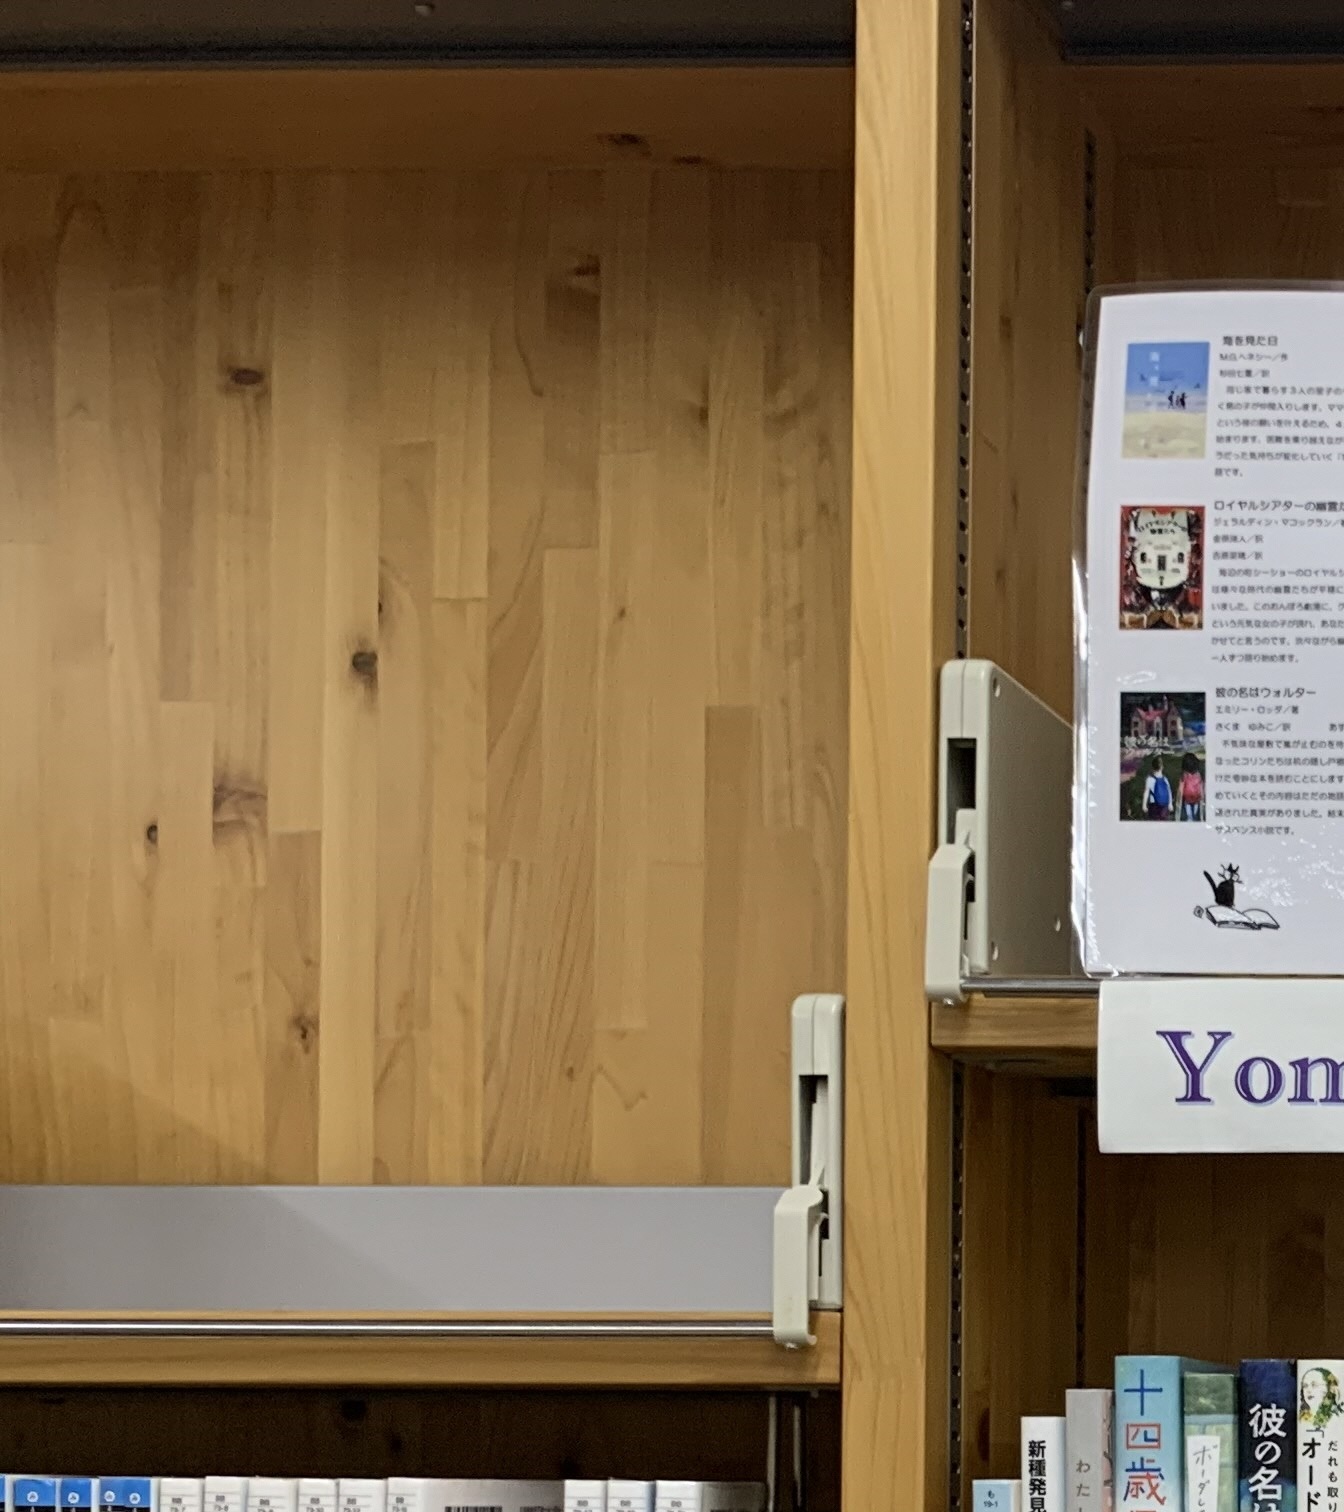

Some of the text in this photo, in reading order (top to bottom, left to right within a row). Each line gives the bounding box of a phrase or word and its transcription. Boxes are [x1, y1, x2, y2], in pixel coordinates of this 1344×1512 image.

[1216, 687, 1317, 698] 彼の名はウォルター
